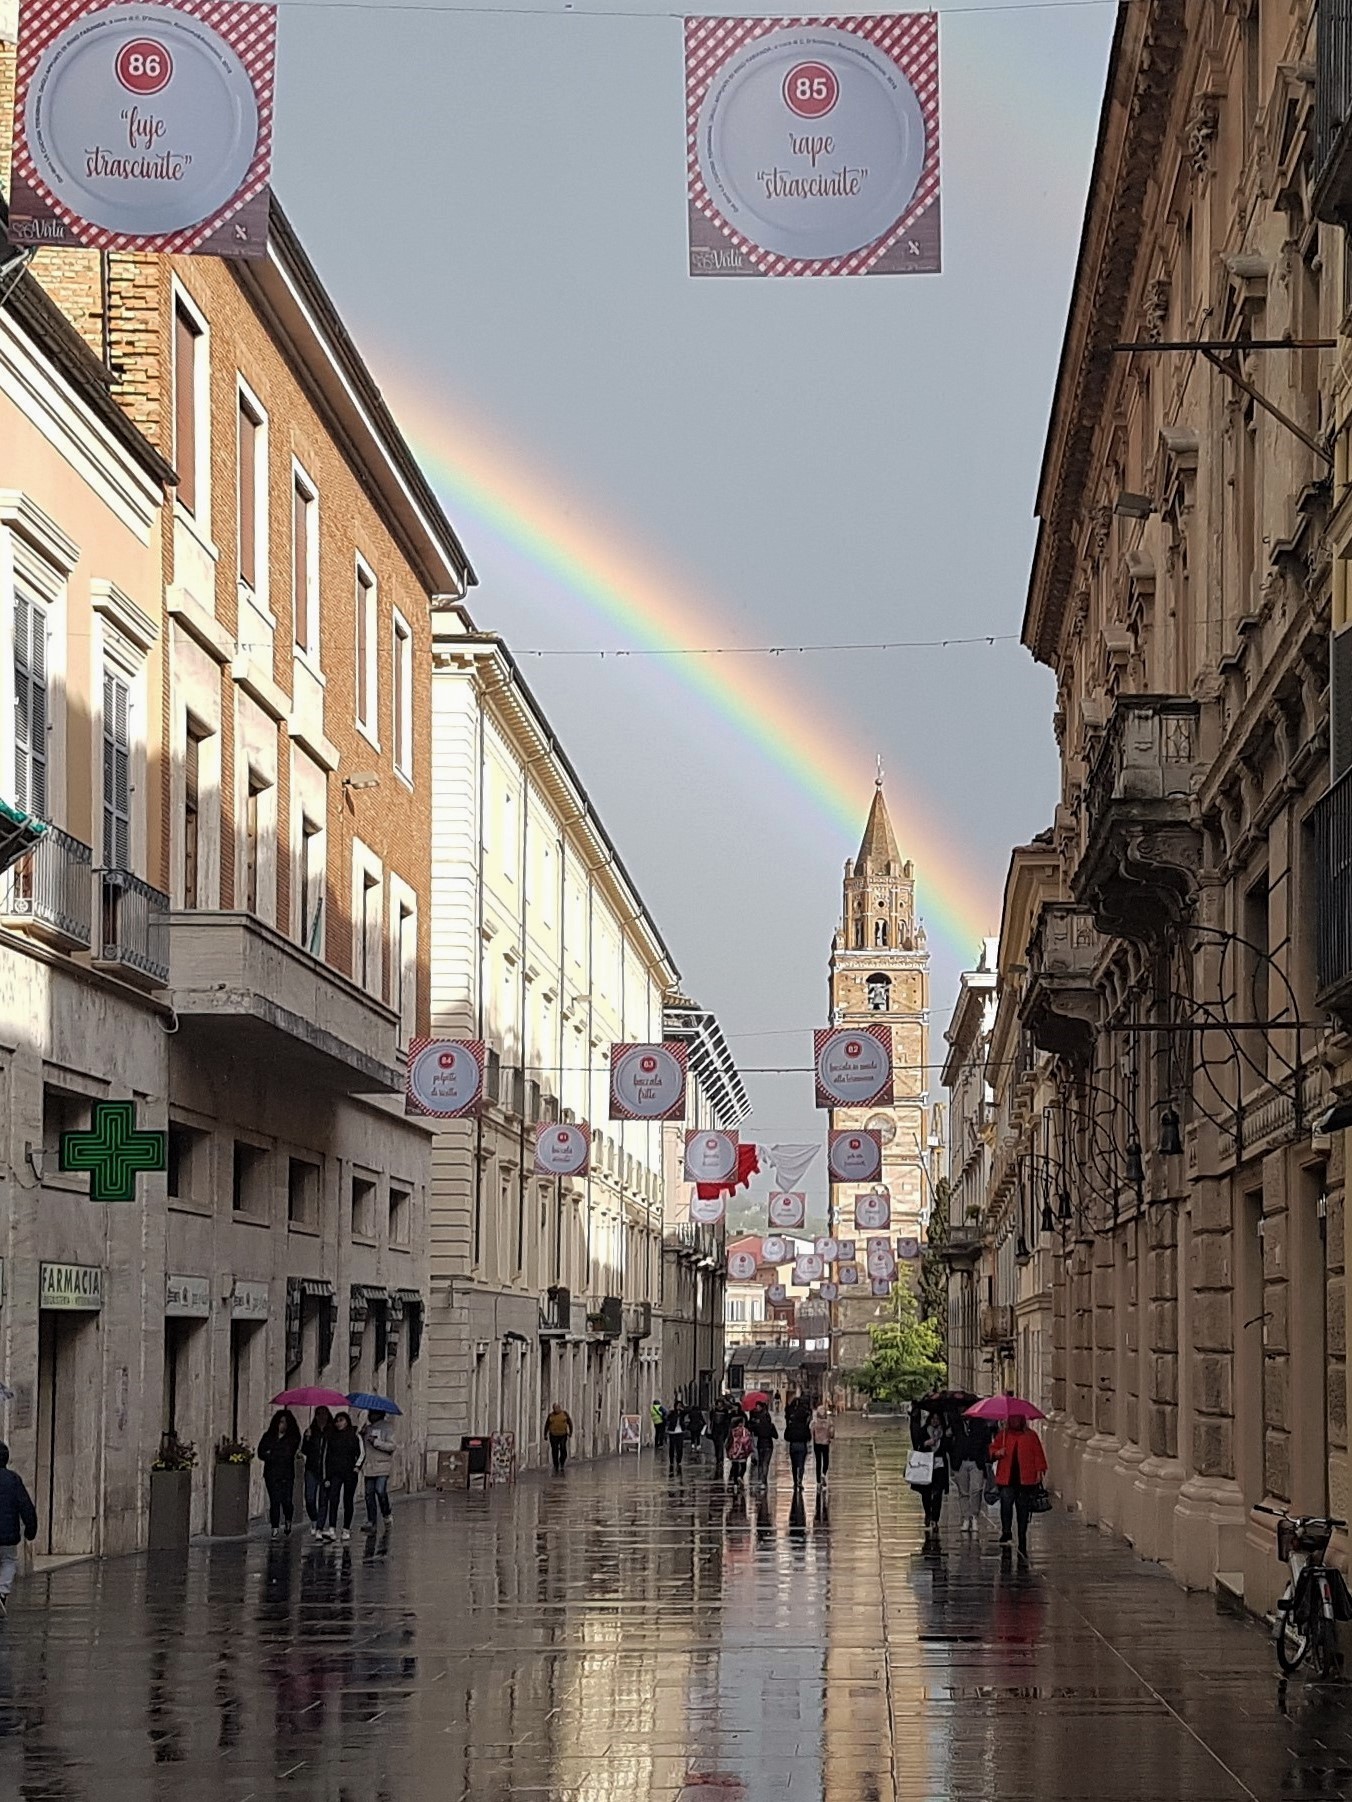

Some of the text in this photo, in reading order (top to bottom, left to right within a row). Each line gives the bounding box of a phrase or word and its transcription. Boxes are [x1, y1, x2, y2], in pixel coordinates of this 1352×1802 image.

[128, 54, 161, 77] 86
[796, 78, 827, 100] 85
[789, 132, 835, 168] rape
[42, 1267, 100, 1295] FARMACIA
